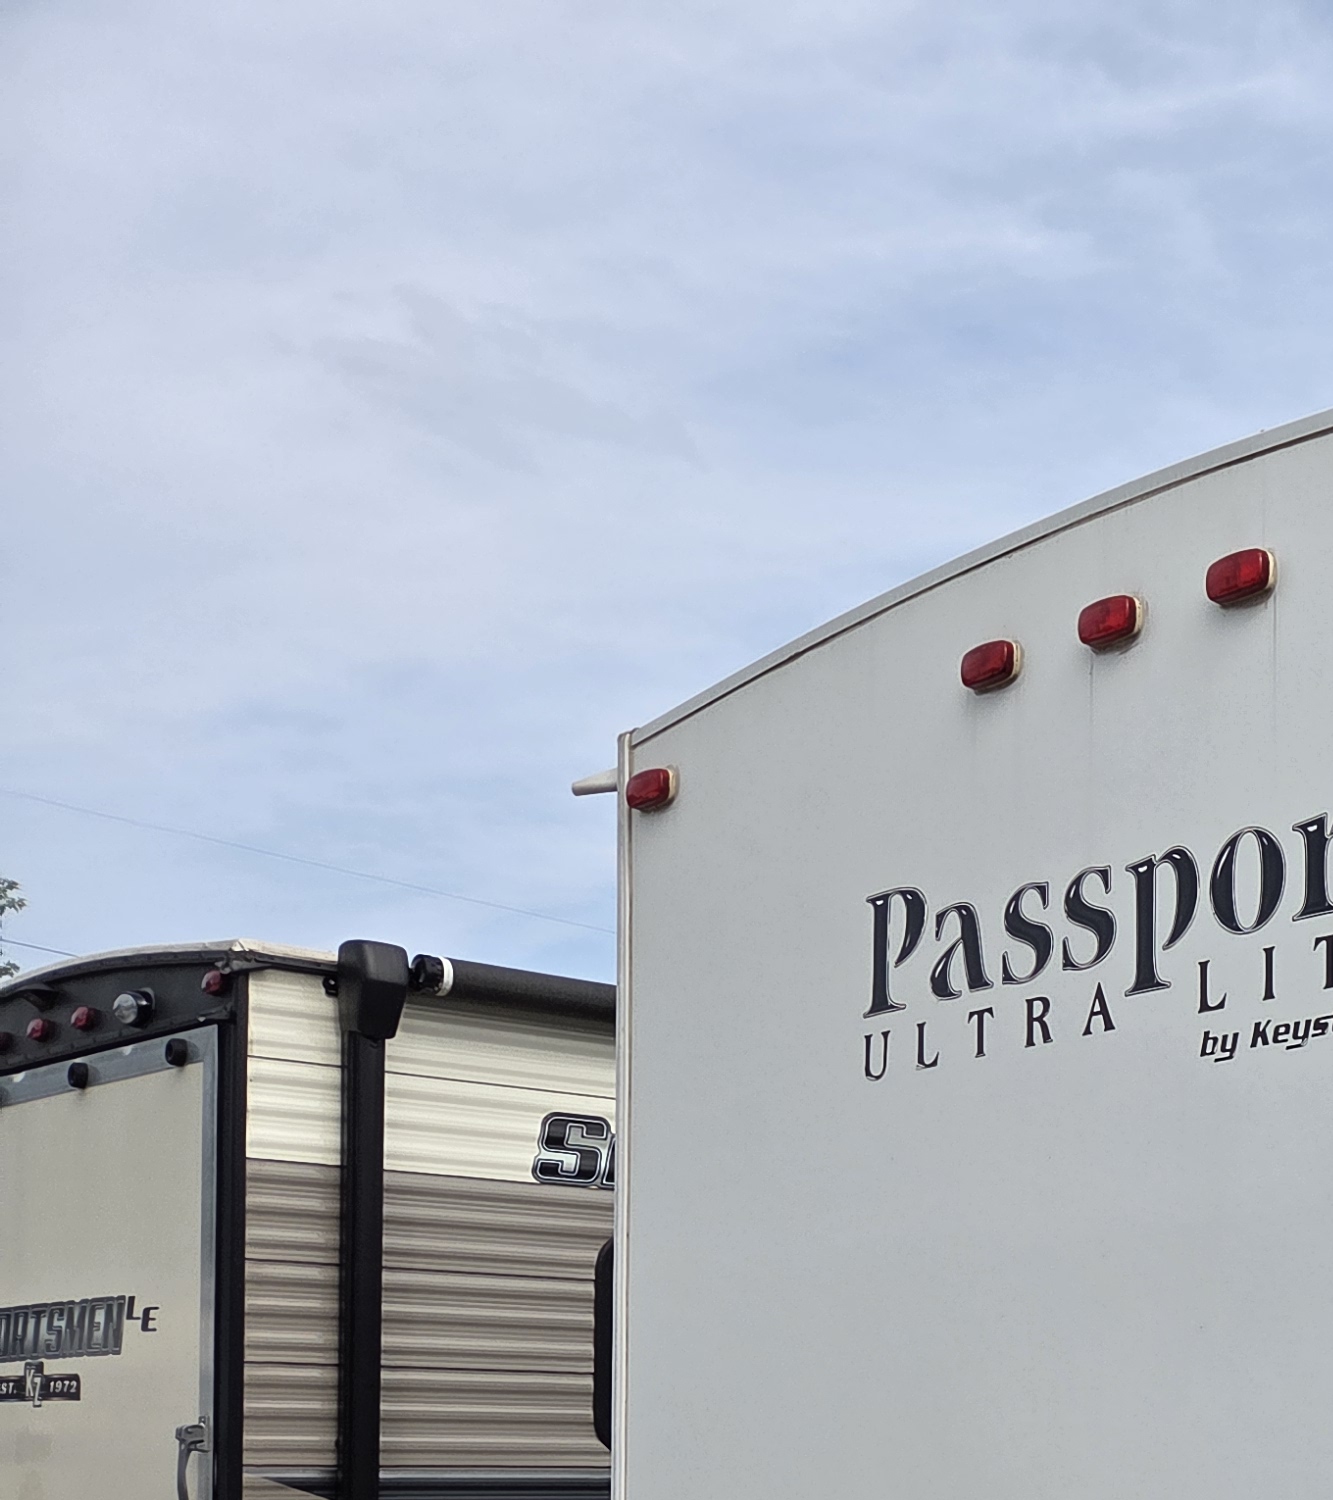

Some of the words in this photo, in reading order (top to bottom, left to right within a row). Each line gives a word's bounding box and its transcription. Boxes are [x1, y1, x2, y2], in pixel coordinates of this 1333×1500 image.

[864, 981, 1116, 1081] ULTRA
[1200, 1030, 1239, 1063] by
[50, 1380, 78, 1393] 1972
